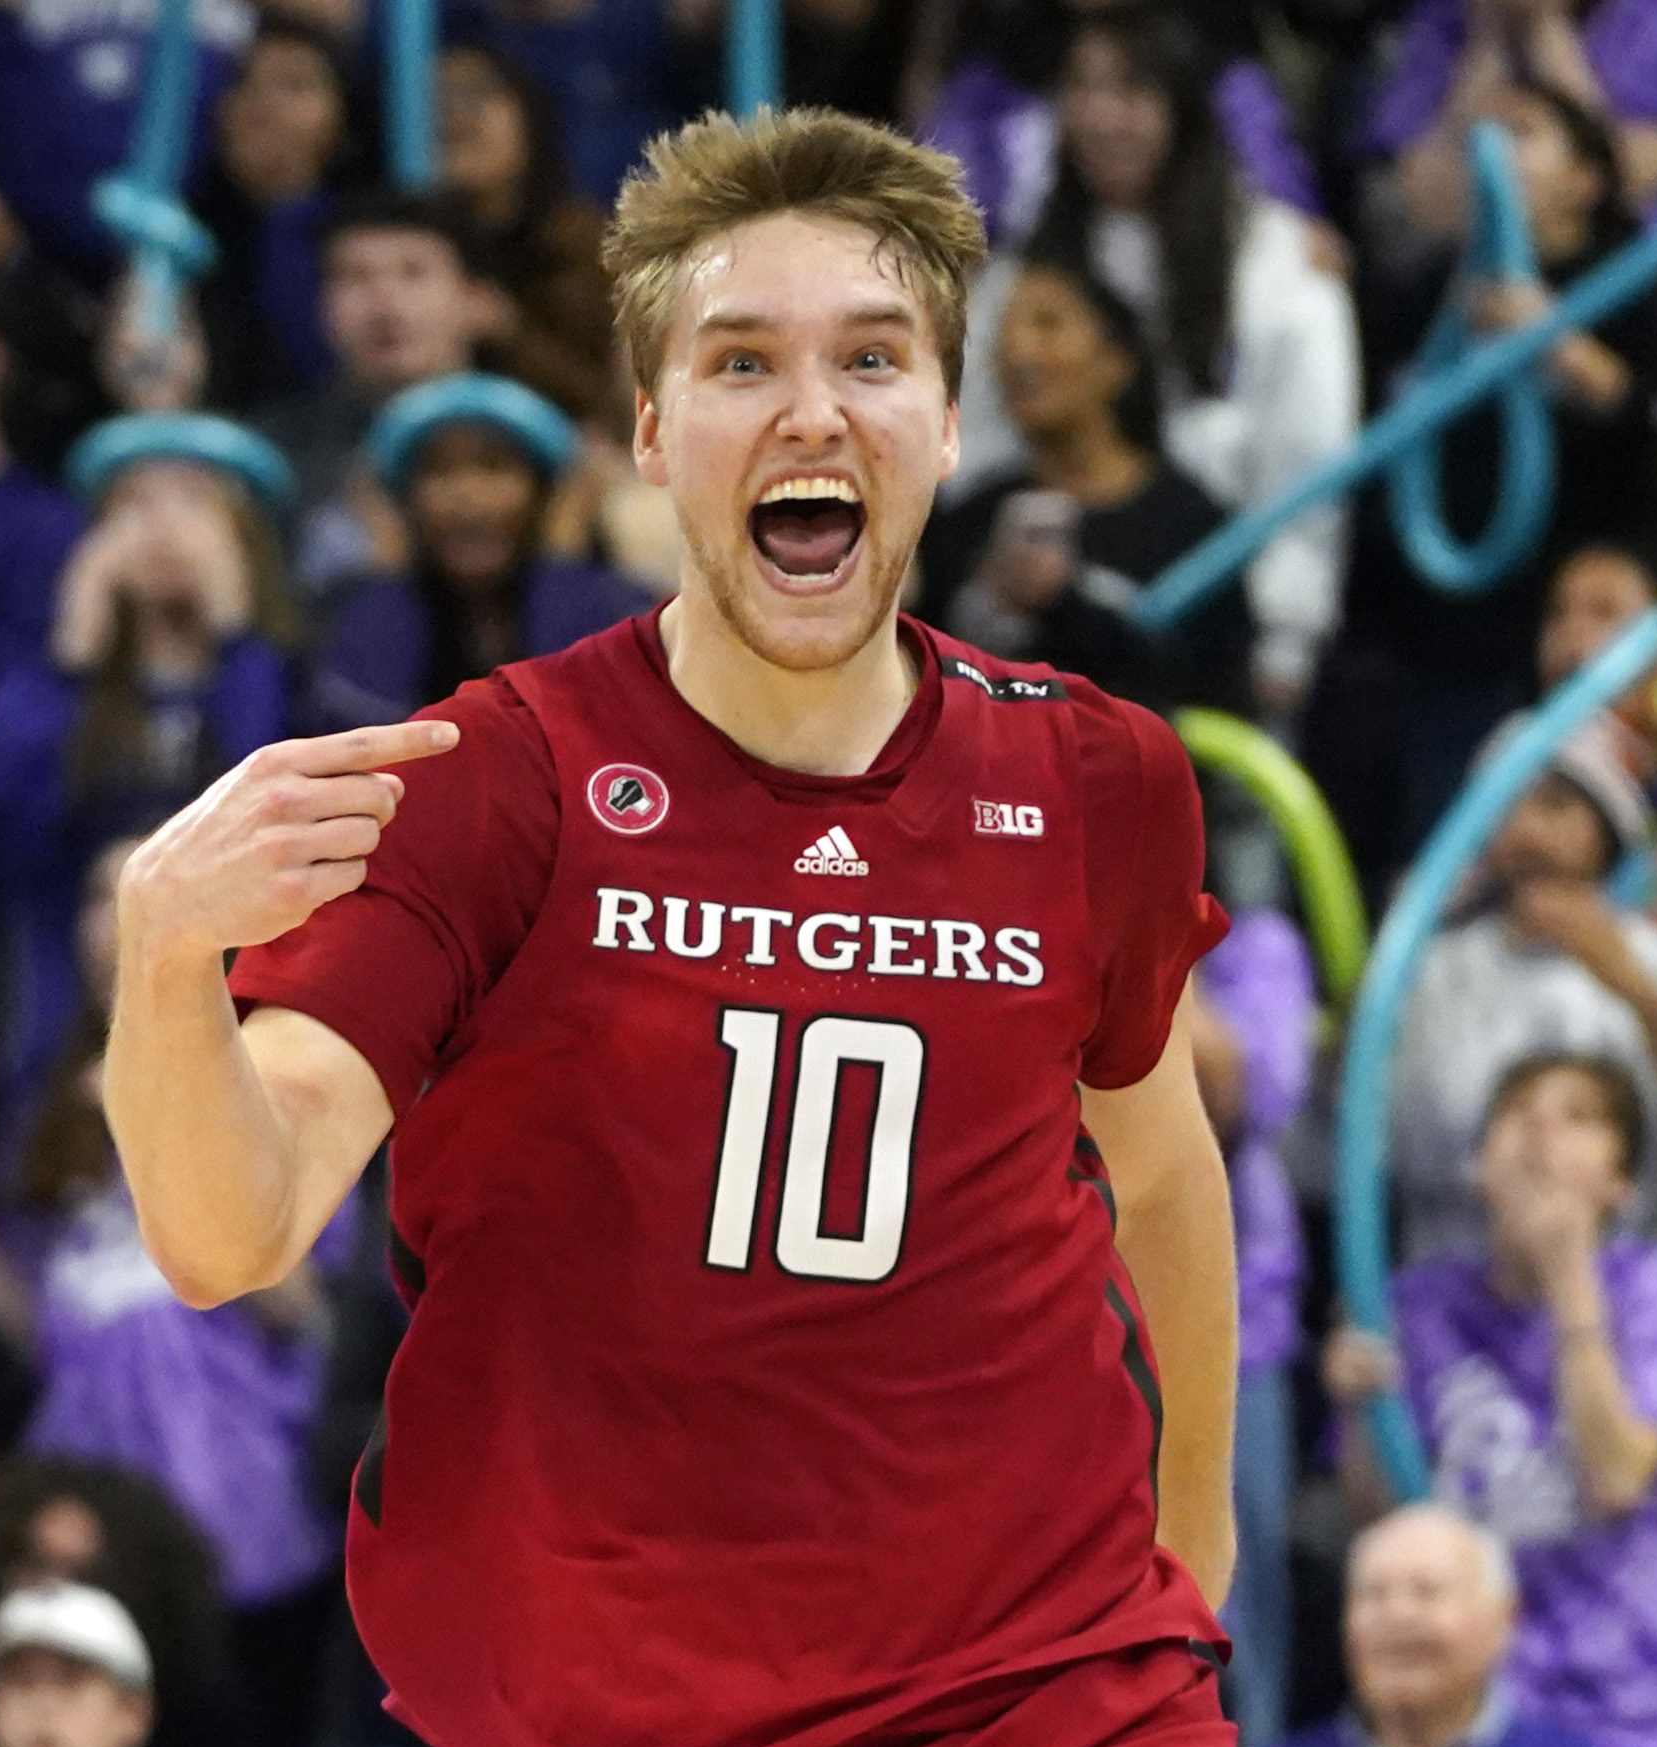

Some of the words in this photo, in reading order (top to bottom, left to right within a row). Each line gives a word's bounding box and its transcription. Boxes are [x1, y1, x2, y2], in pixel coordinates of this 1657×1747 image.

[793, 855, 870, 878] adidas
[592, 887, 1045, 987] RUTGERS
[703, 1005, 925, 1282] 10
